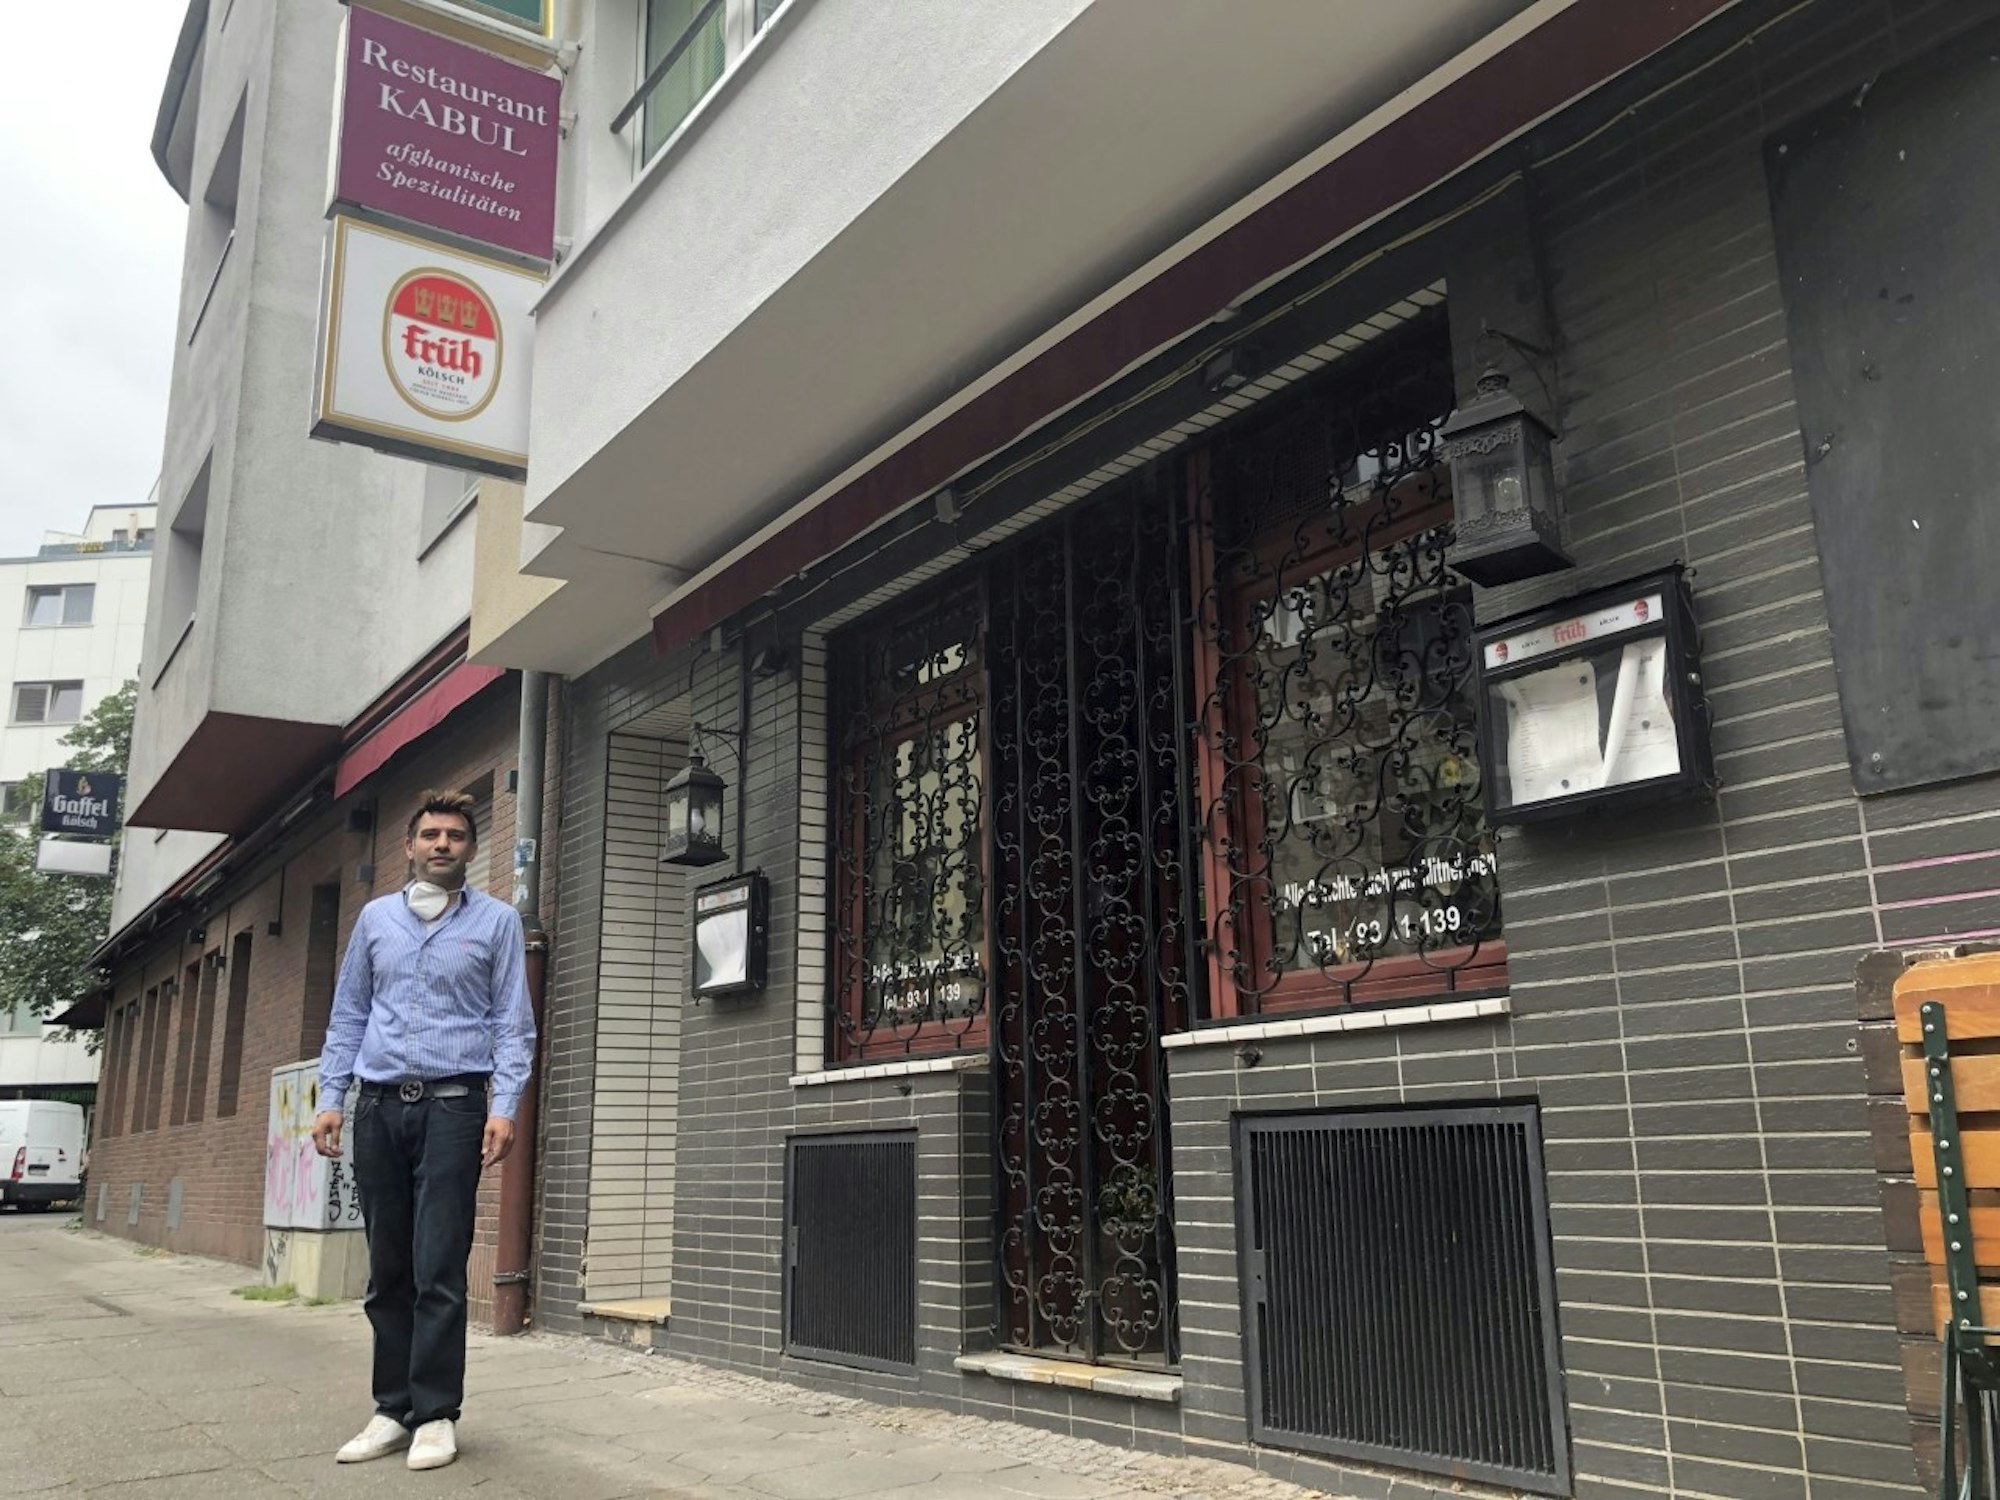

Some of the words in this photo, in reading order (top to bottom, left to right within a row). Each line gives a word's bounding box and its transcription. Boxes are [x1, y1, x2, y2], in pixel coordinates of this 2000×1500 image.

[360, 37, 548, 126] Restaurant
[378, 82, 528, 156] KABUL
[386, 143, 515, 194] afghanische
[376, 161, 521, 222] Spezialitäten
[401, 324, 482, 379] Früh
[418, 366, 465, 385] KÖLSCH
[52, 794, 109, 817] Gaffel
[62, 815, 98, 829] Kölsch
[1360, 866, 1391, 897] uch
[1420, 906, 1461, 935] 139
[940, 982, 961, 1002] 139
